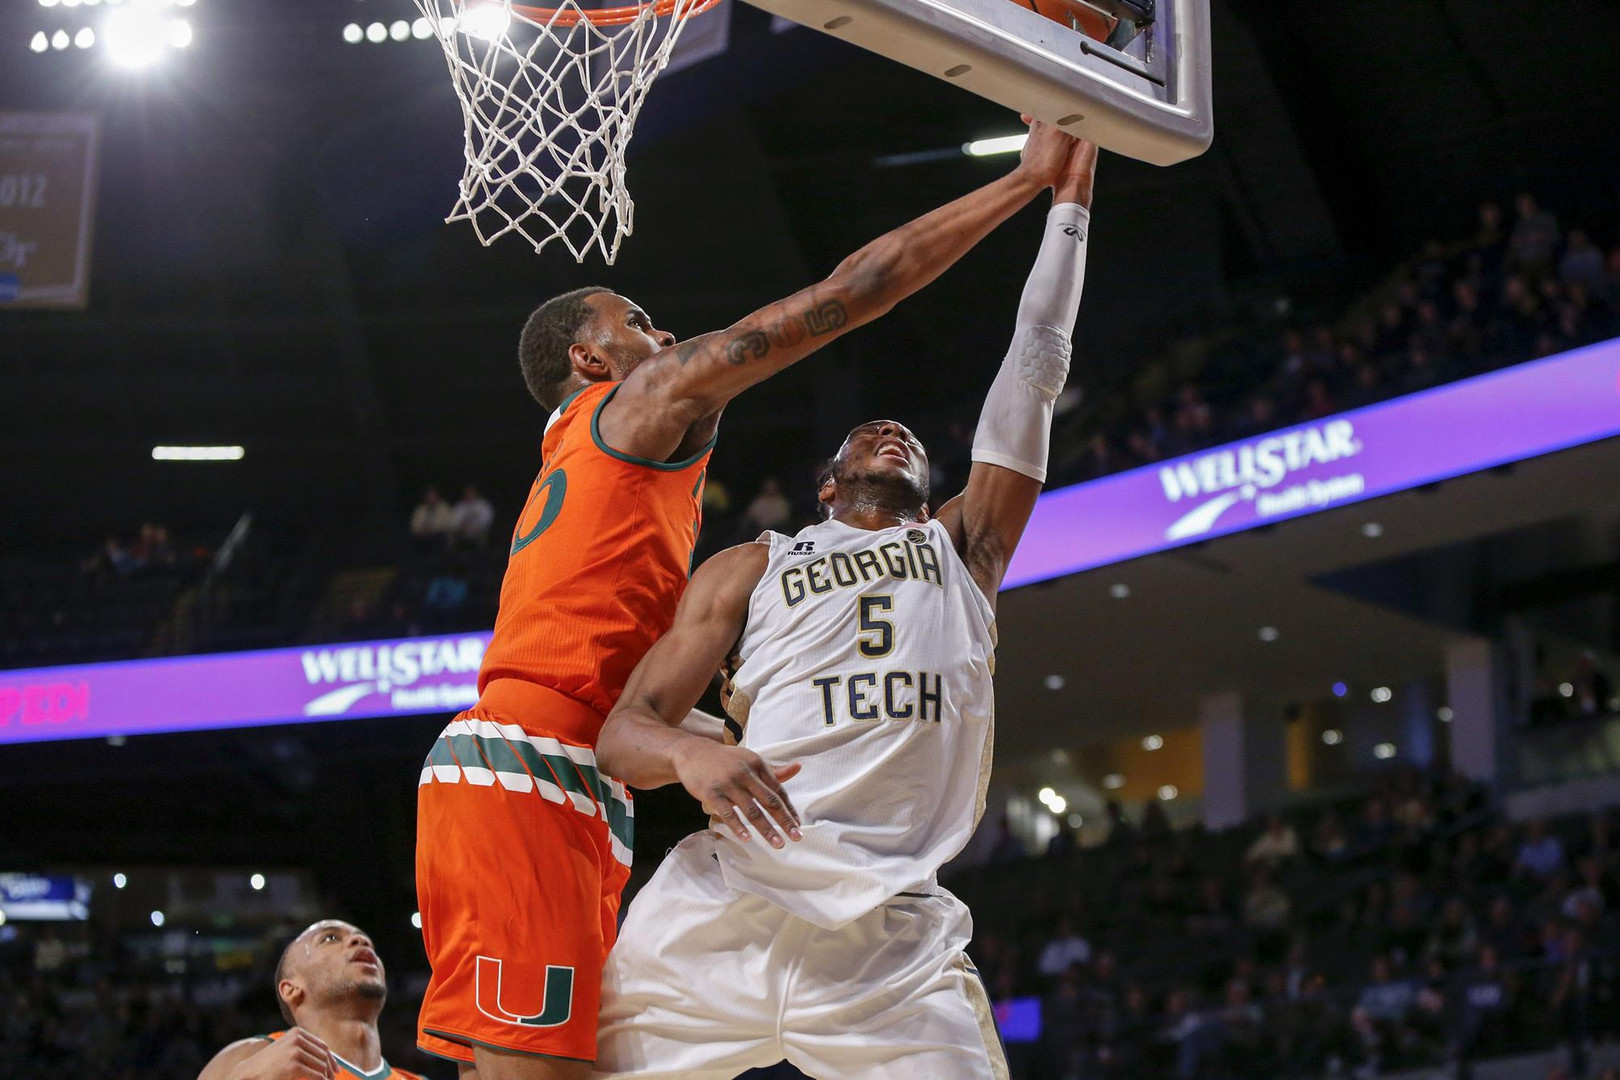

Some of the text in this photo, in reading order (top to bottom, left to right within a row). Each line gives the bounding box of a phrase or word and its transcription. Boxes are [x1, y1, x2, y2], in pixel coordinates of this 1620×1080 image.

[1158, 419, 1362, 502] WELLSTAR
[781, 540, 943, 609] GEORGIA
[857, 593, 895, 659] 5
[301, 638, 484, 685] WELLSTAR
[811, 670, 943, 727] TECH
[475, 955, 575, 1028] U
